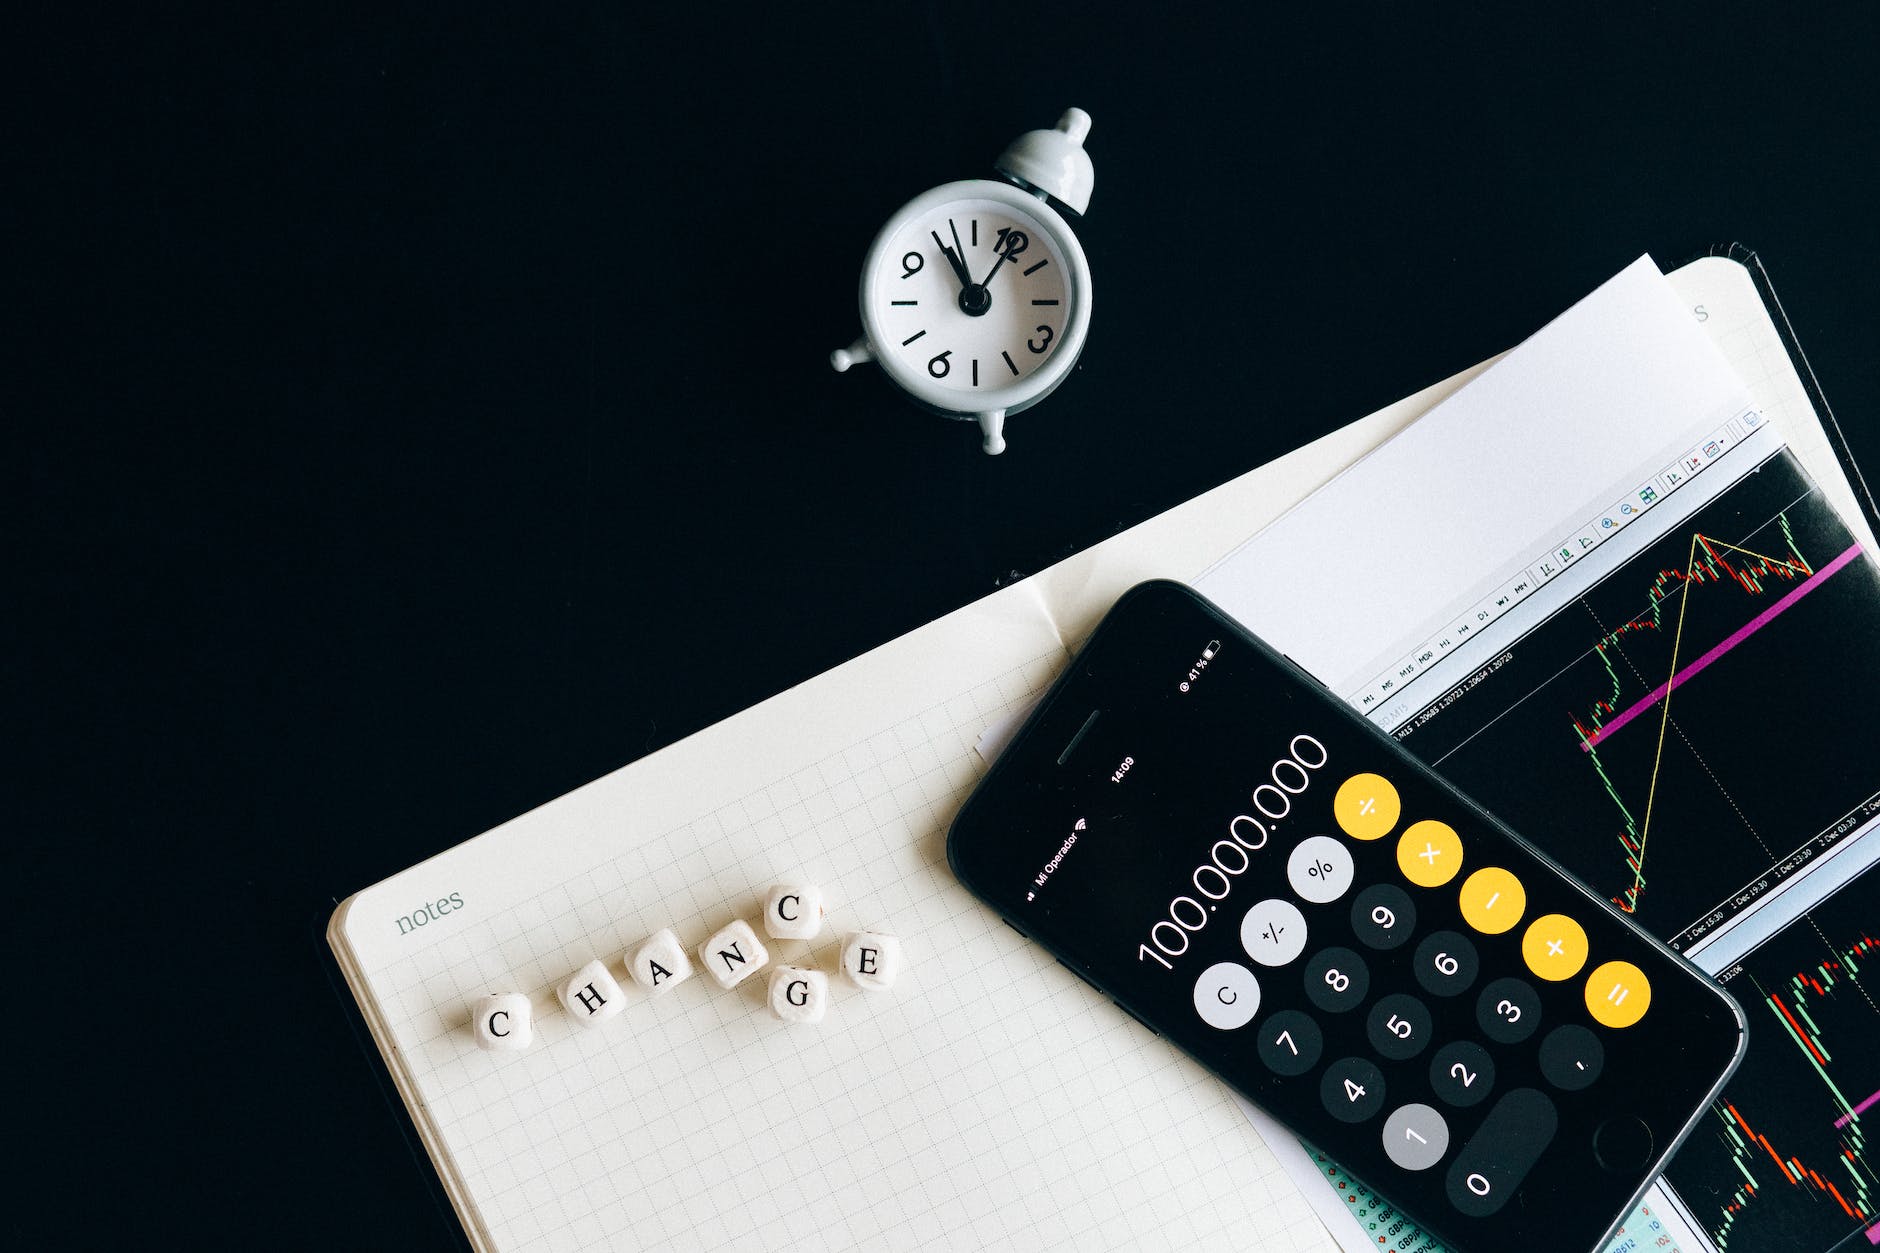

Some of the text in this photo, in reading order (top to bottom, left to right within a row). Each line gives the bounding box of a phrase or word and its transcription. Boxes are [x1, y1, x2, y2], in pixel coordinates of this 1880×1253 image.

[901, 251, 925, 280] 9
[993, 226, 1029, 264] 12
[1027, 325, 1054, 354] 3
[927, 350, 953, 379] 6
[1363, 694, 1375, 705] M1
[1381, 680, 1394, 691] M5
[1399, 664, 1415, 678] M15
[1439, 639, 1451, 649] H1
[1458, 625, 1470, 635] H4
[1477, 610, 1489, 621] D1
[1496, 595, 1509, 607] W1
[1488, 652, 1513, 674] 1.20720
[1189, 668, 1201, 681] 41
[1111, 756, 1134, 784] 14:09
[1035, 832, 1078, 886] Mi Operador
[1139, 734, 1328, 970] 100.000.000
[395, 892, 464, 936] notes
[1217, 986, 1237, 1005] C
[1308, 858, 1333, 881] %
[1276, 1030, 1299, 1056] 7
[1324, 968, 1350, 992] 8
[1371, 906, 1396, 929] 9
[1343, 1078, 1366, 1102] 4
[1386, 1015, 1412, 1039] 5
[1434, 952, 1459, 976] 6
[1406, 1127, 1428, 1145] 1
[1450, 1062, 1477, 1088] 2
[1496, 1000, 1522, 1023] 3
[1466, 1173, 1491, 1196] 0
